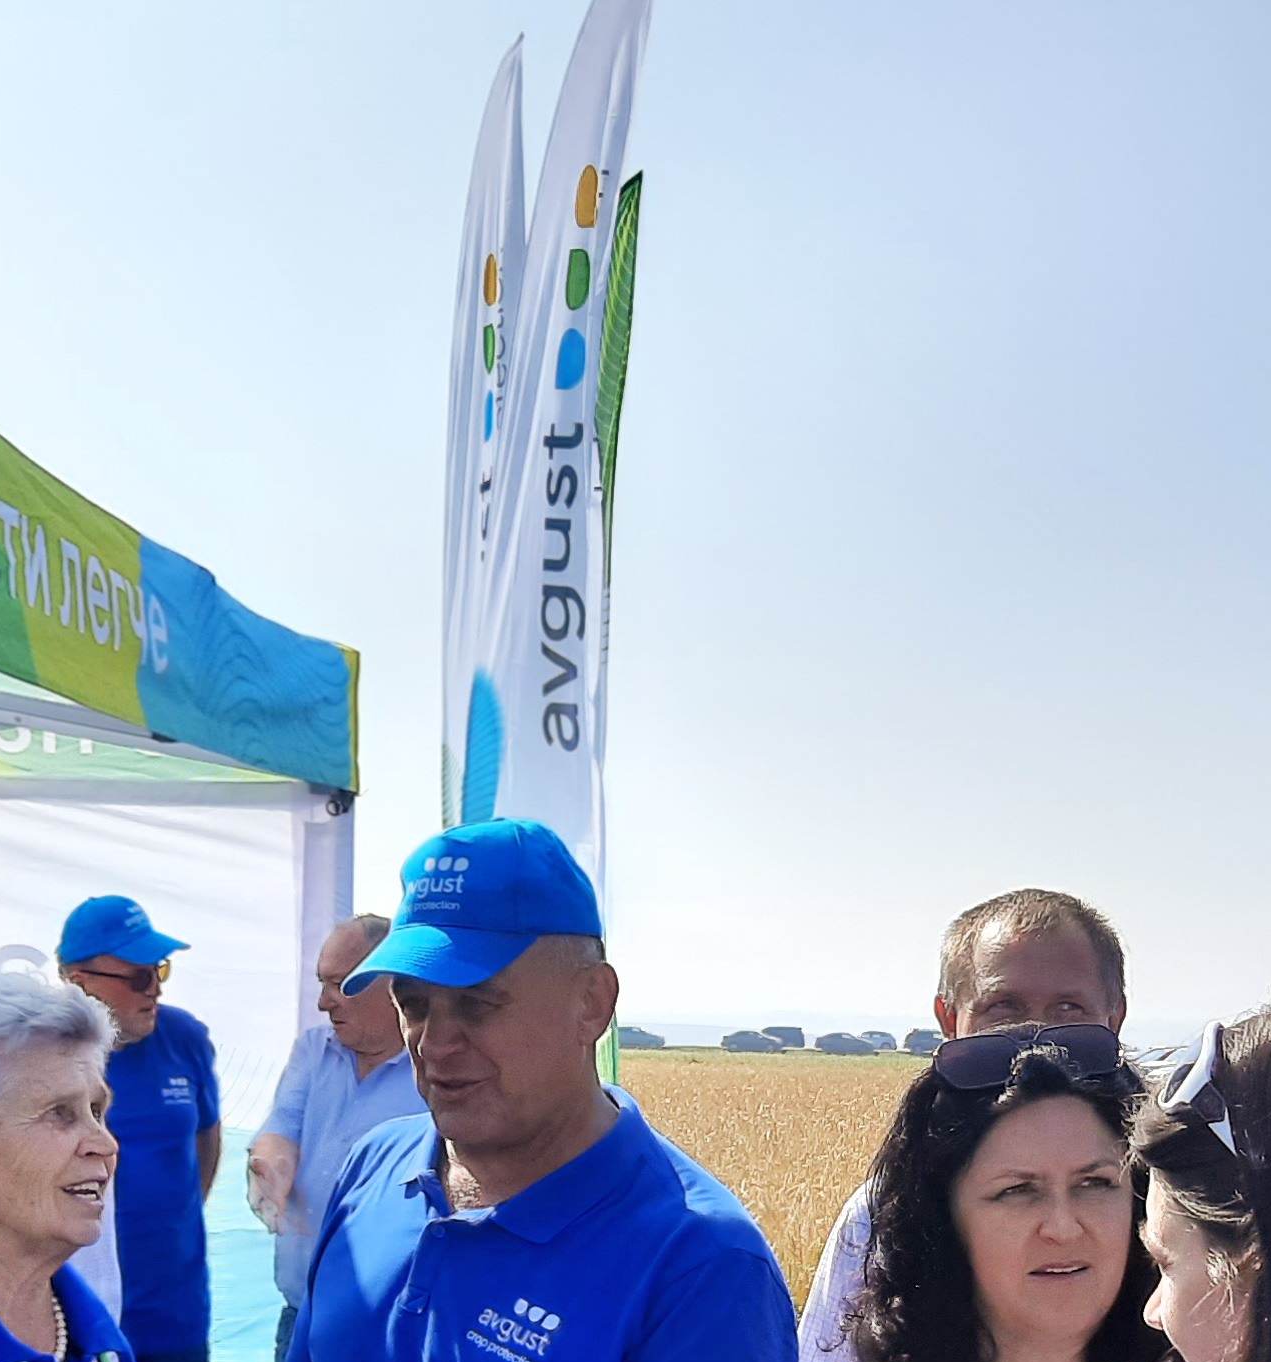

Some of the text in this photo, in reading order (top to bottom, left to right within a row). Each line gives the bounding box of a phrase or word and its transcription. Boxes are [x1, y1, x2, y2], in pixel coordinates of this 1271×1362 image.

[59, 537, 169, 674] легче
[541, 422, 587, 752] avgust
[408, 874, 465, 899] vgust
[466, 1330, 488, 1348] crop
[478, 1308, 550, 1356] avgust
